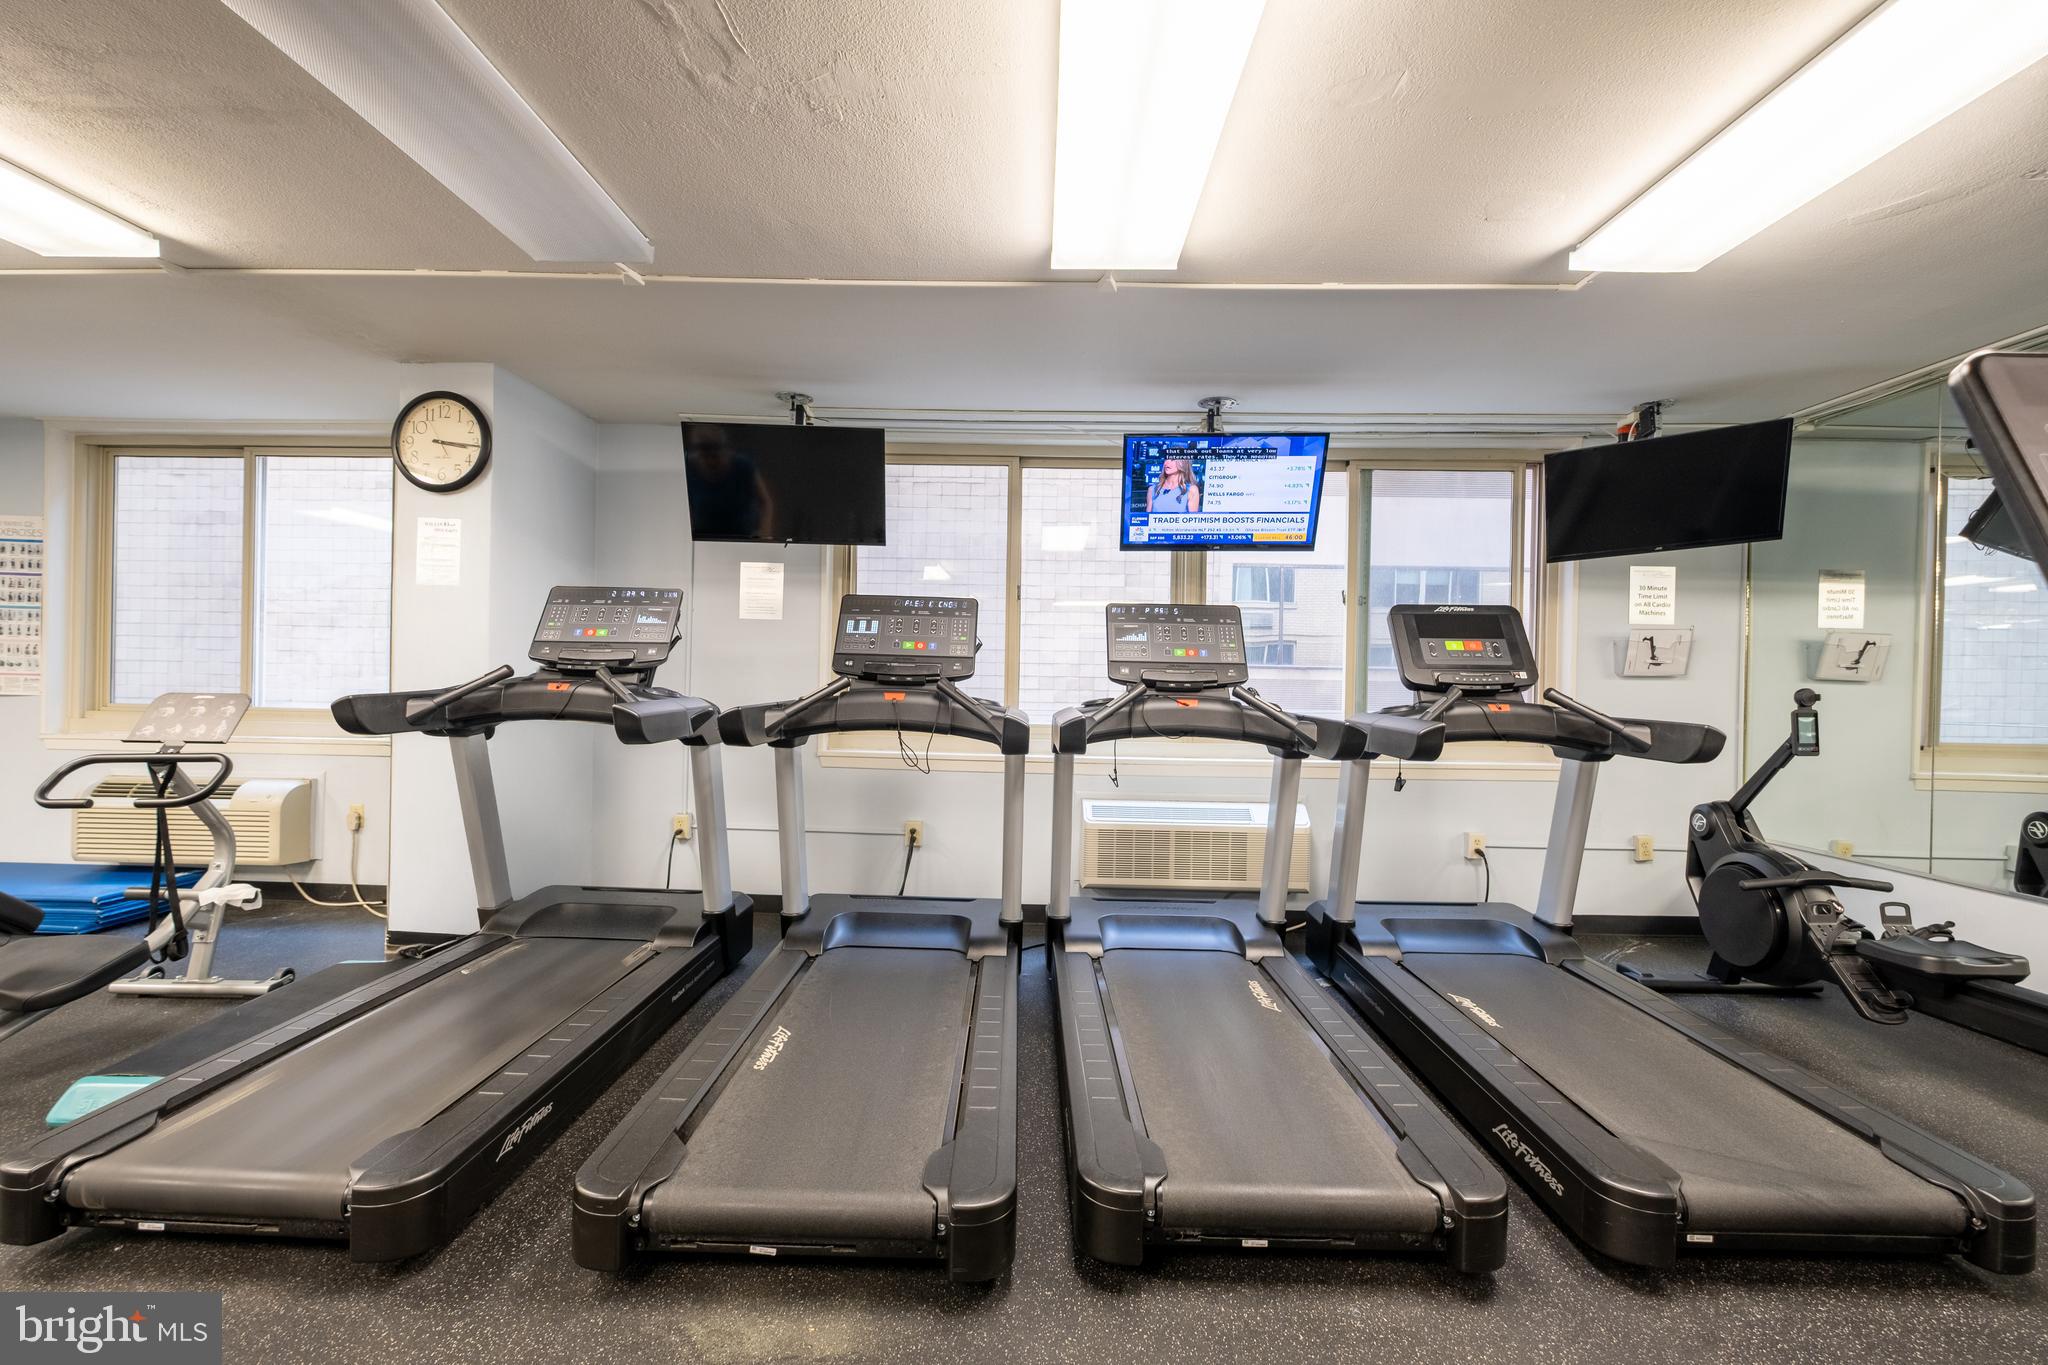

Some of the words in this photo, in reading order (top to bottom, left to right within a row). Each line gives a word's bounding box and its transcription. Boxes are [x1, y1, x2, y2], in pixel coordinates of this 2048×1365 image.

[426, 408, 434, 421] 11
[439, 405, 451, 419] 12
[412, 420, 428, 434] 10
